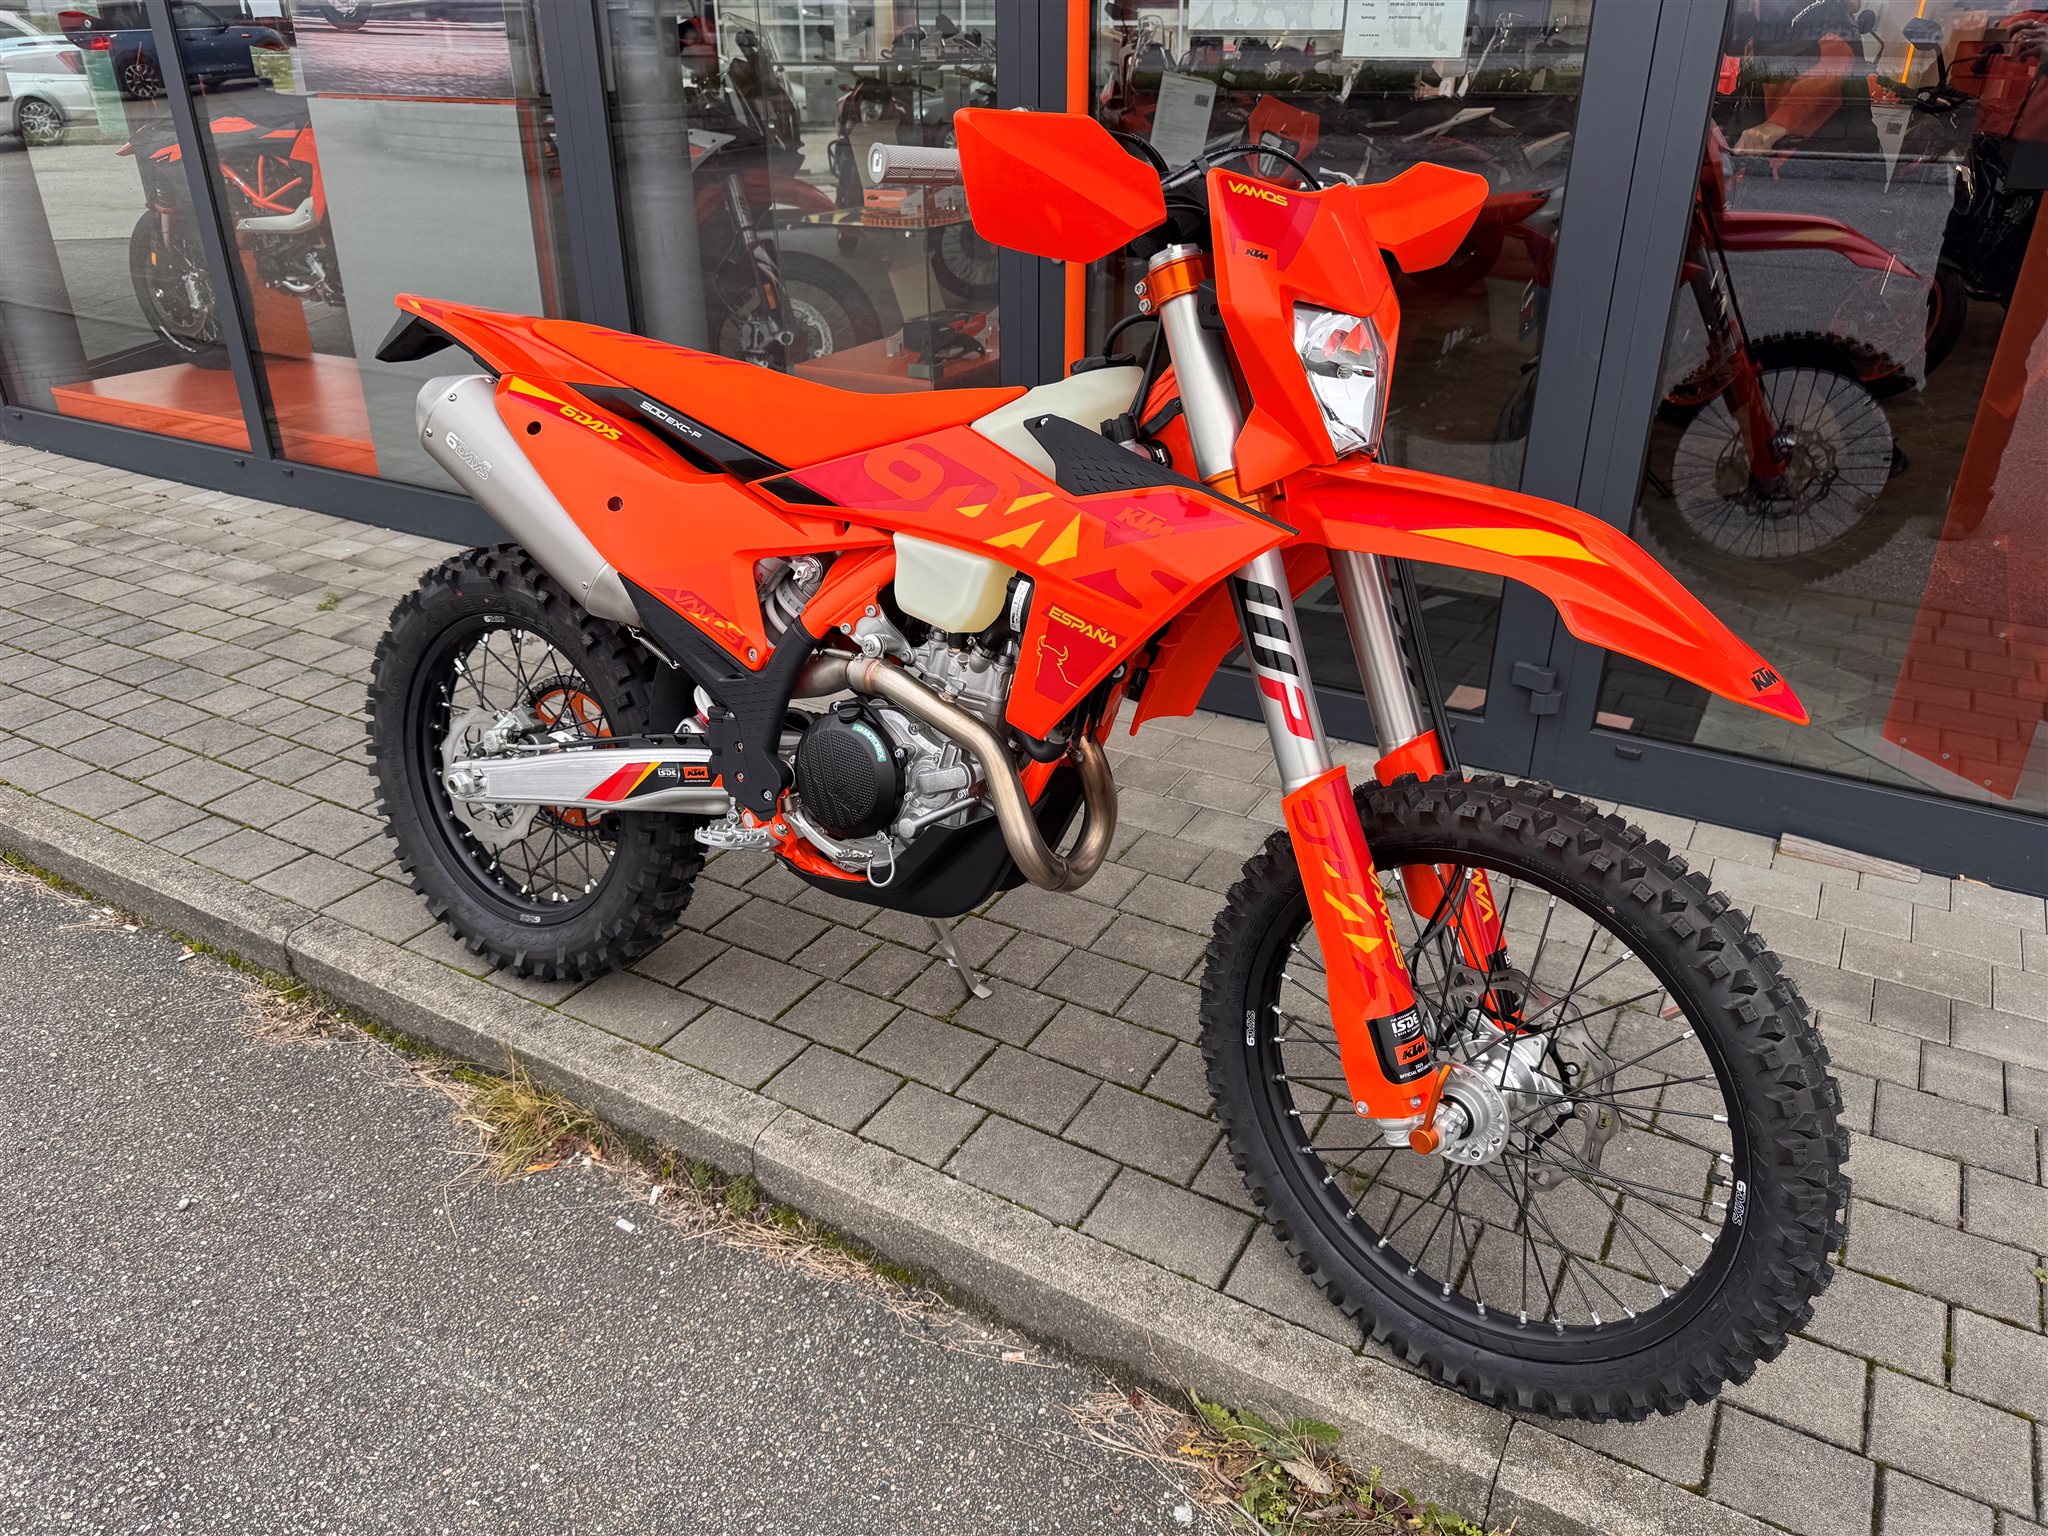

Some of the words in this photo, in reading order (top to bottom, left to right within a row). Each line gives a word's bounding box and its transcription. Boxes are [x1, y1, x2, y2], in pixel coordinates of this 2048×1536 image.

[1228, 180, 1288, 206] VAMOS
[1246, 248, 1269, 261] KTM
[1115, 506, 1178, 538] KTM
[673, 589, 741, 646] VAMOS
[1048, 605, 1118, 649] ESPAÑA
[1751, 667, 1780, 692] KTM
[687, 769, 705, 777] KTM
[1367, 861, 1405, 970] VAMOS
[1391, 1012, 1419, 1034] ISDE
[1402, 1043, 1426, 1061] KTM
